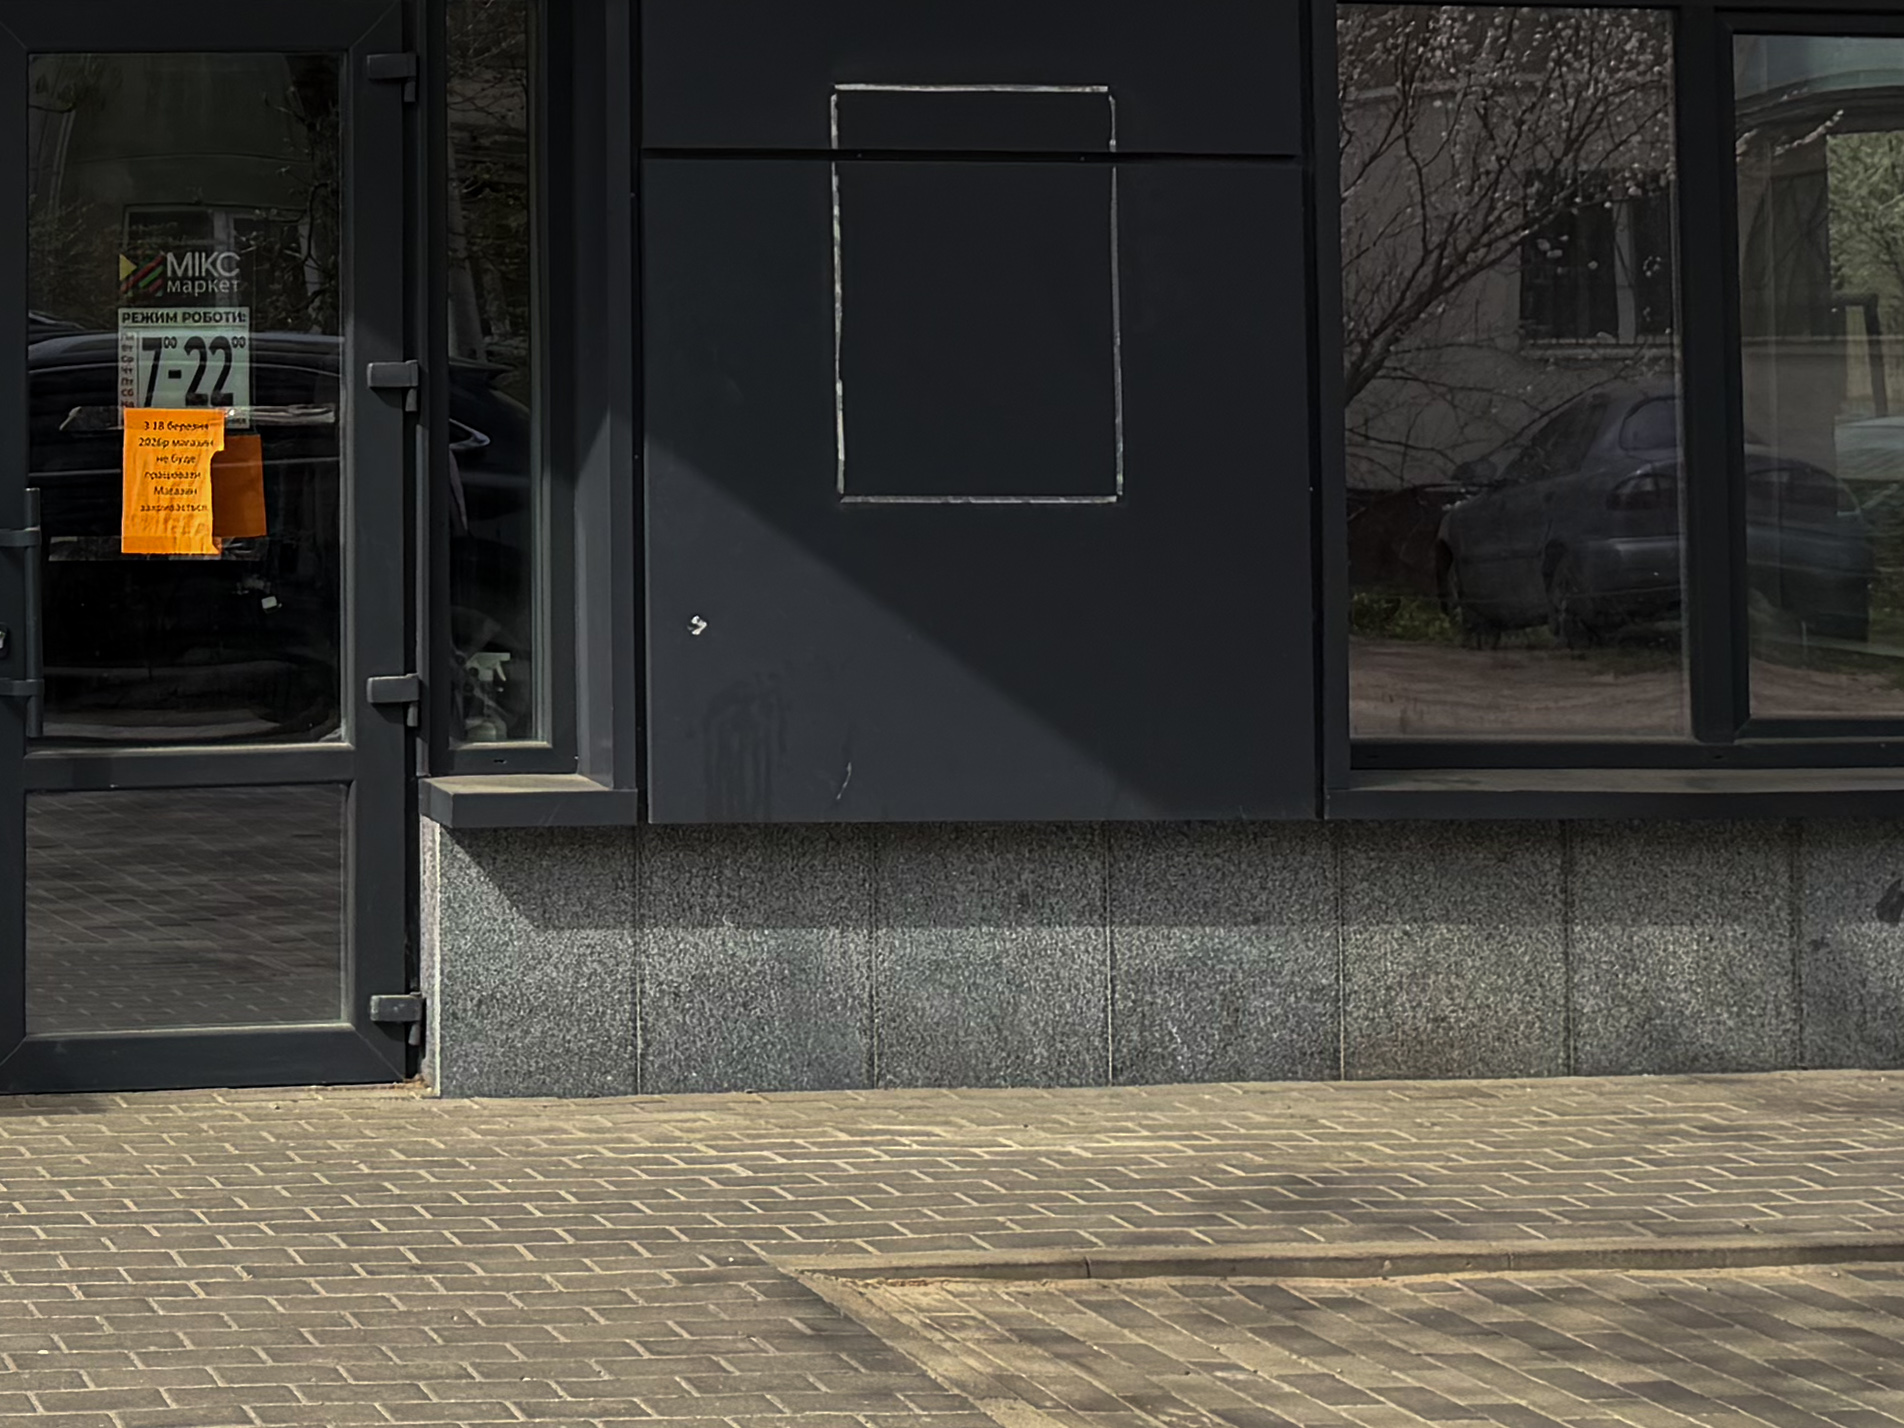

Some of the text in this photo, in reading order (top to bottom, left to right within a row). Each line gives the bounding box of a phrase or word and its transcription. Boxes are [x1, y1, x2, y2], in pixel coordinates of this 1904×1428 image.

[166, 251, 241, 277] МІКС
[166, 279, 241, 297] маркет
[121, 311, 247, 324] РЕЖИМ РОБОТИ:
[152, 420, 165, 432] 18
[156, 453, 197, 464] не буде
